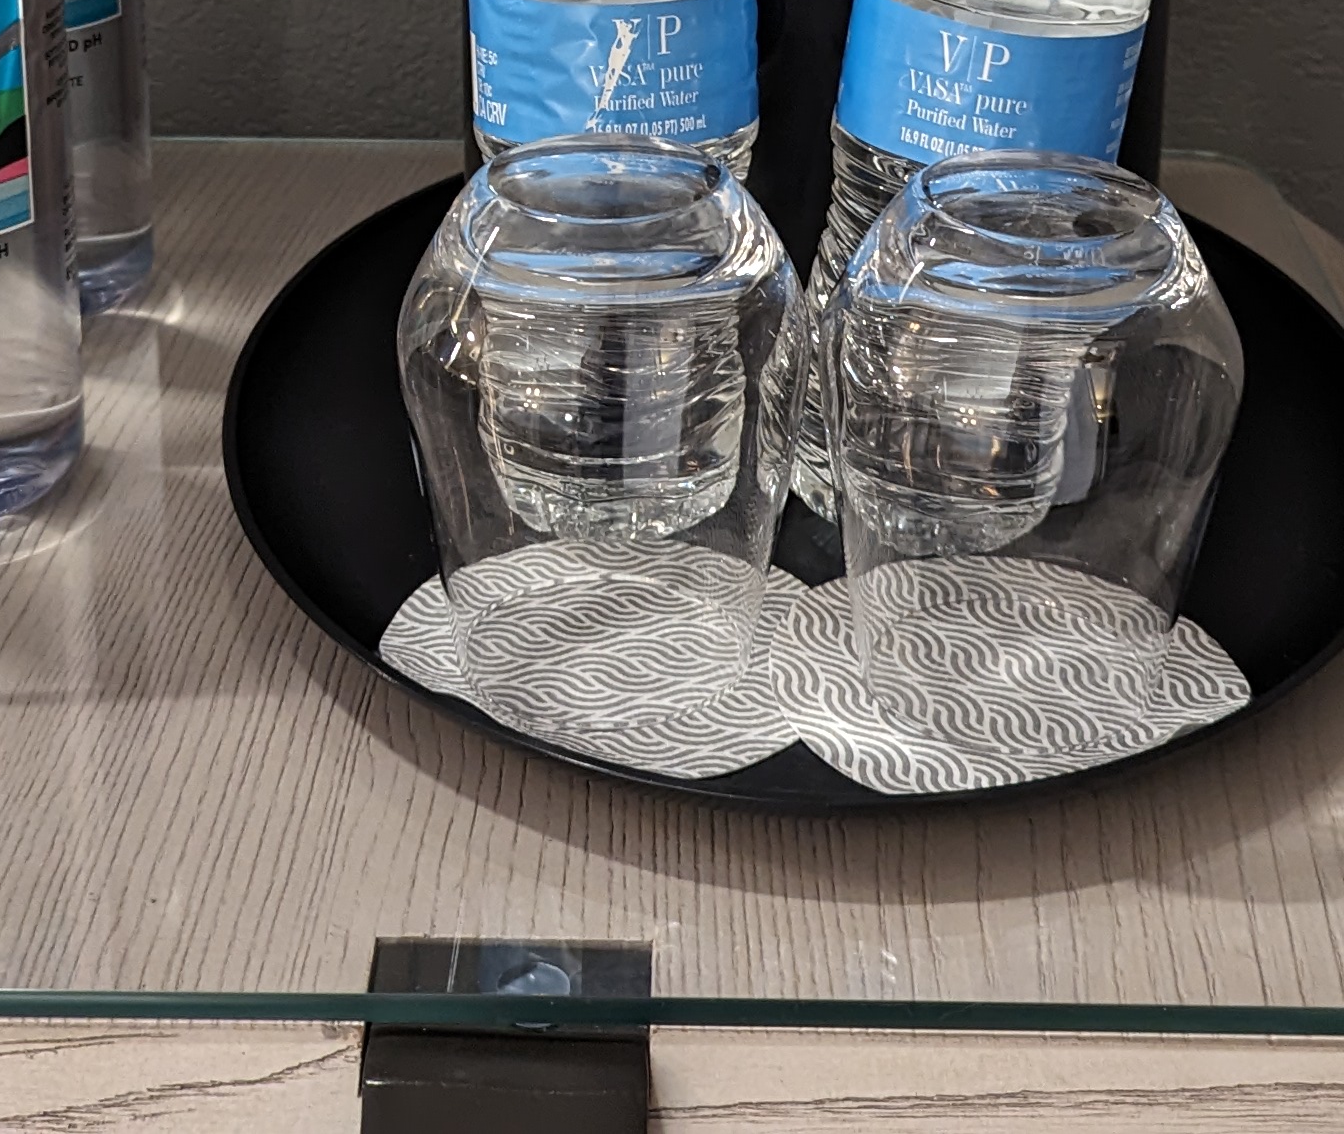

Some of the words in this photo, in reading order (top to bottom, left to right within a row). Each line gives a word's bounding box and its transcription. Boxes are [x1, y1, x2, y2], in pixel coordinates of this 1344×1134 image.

[83, 32, 103, 53] pH
[659, 62, 704, 90] pure
[659, 90, 700, 107] Water
[974, 93, 1028, 116] pure
[664, 118, 678, 136] PT)
[679, 116, 695, 132] 500
[906, 98, 967, 131] Purified
[971, 115, 1017, 139] Water
[900, 126, 919, 145] 16.9
[919, 133, 929, 150] FL
[930, 136, 945, 154] OZ
